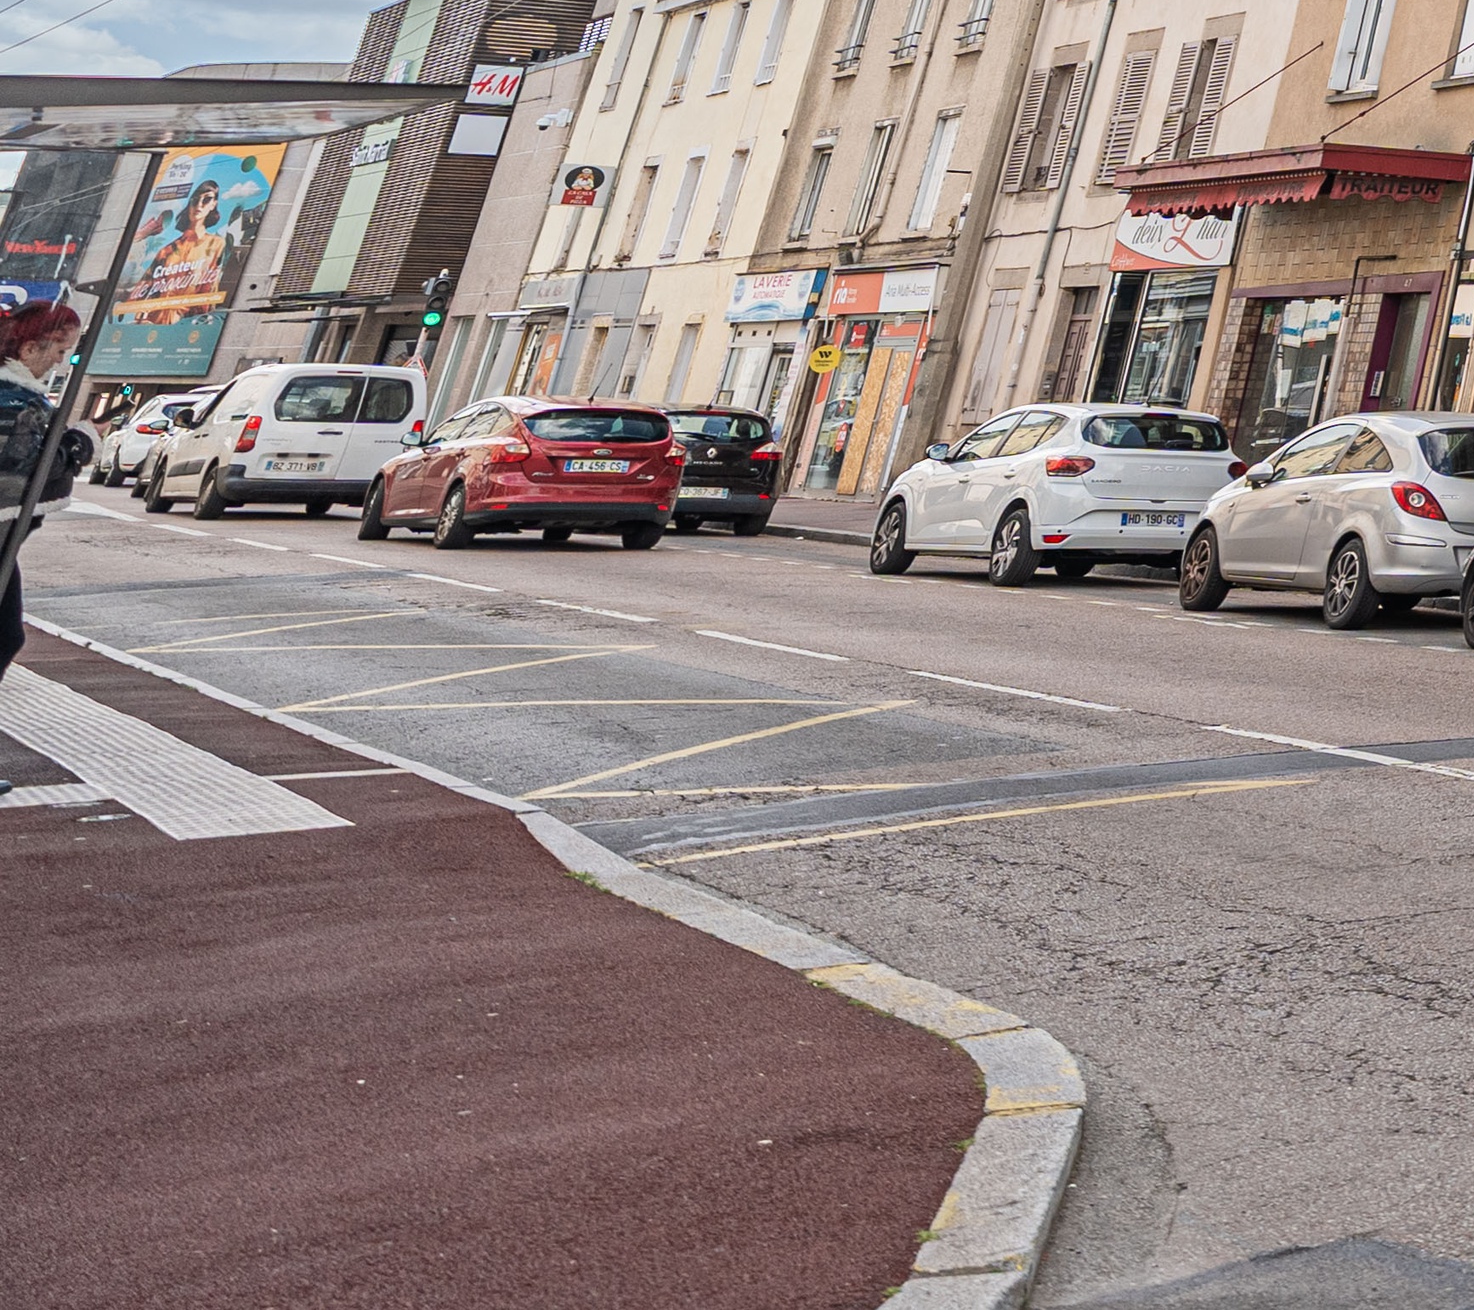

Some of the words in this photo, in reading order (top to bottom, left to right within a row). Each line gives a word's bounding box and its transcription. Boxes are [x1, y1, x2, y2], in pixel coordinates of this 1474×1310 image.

[471, 73, 520, 98] H&M
[1339, 181, 1440, 196] TRAITEUR
[753, 274, 793, 290] LAVERIE
[1128, 514, 1178, 525] HD-190-GC
